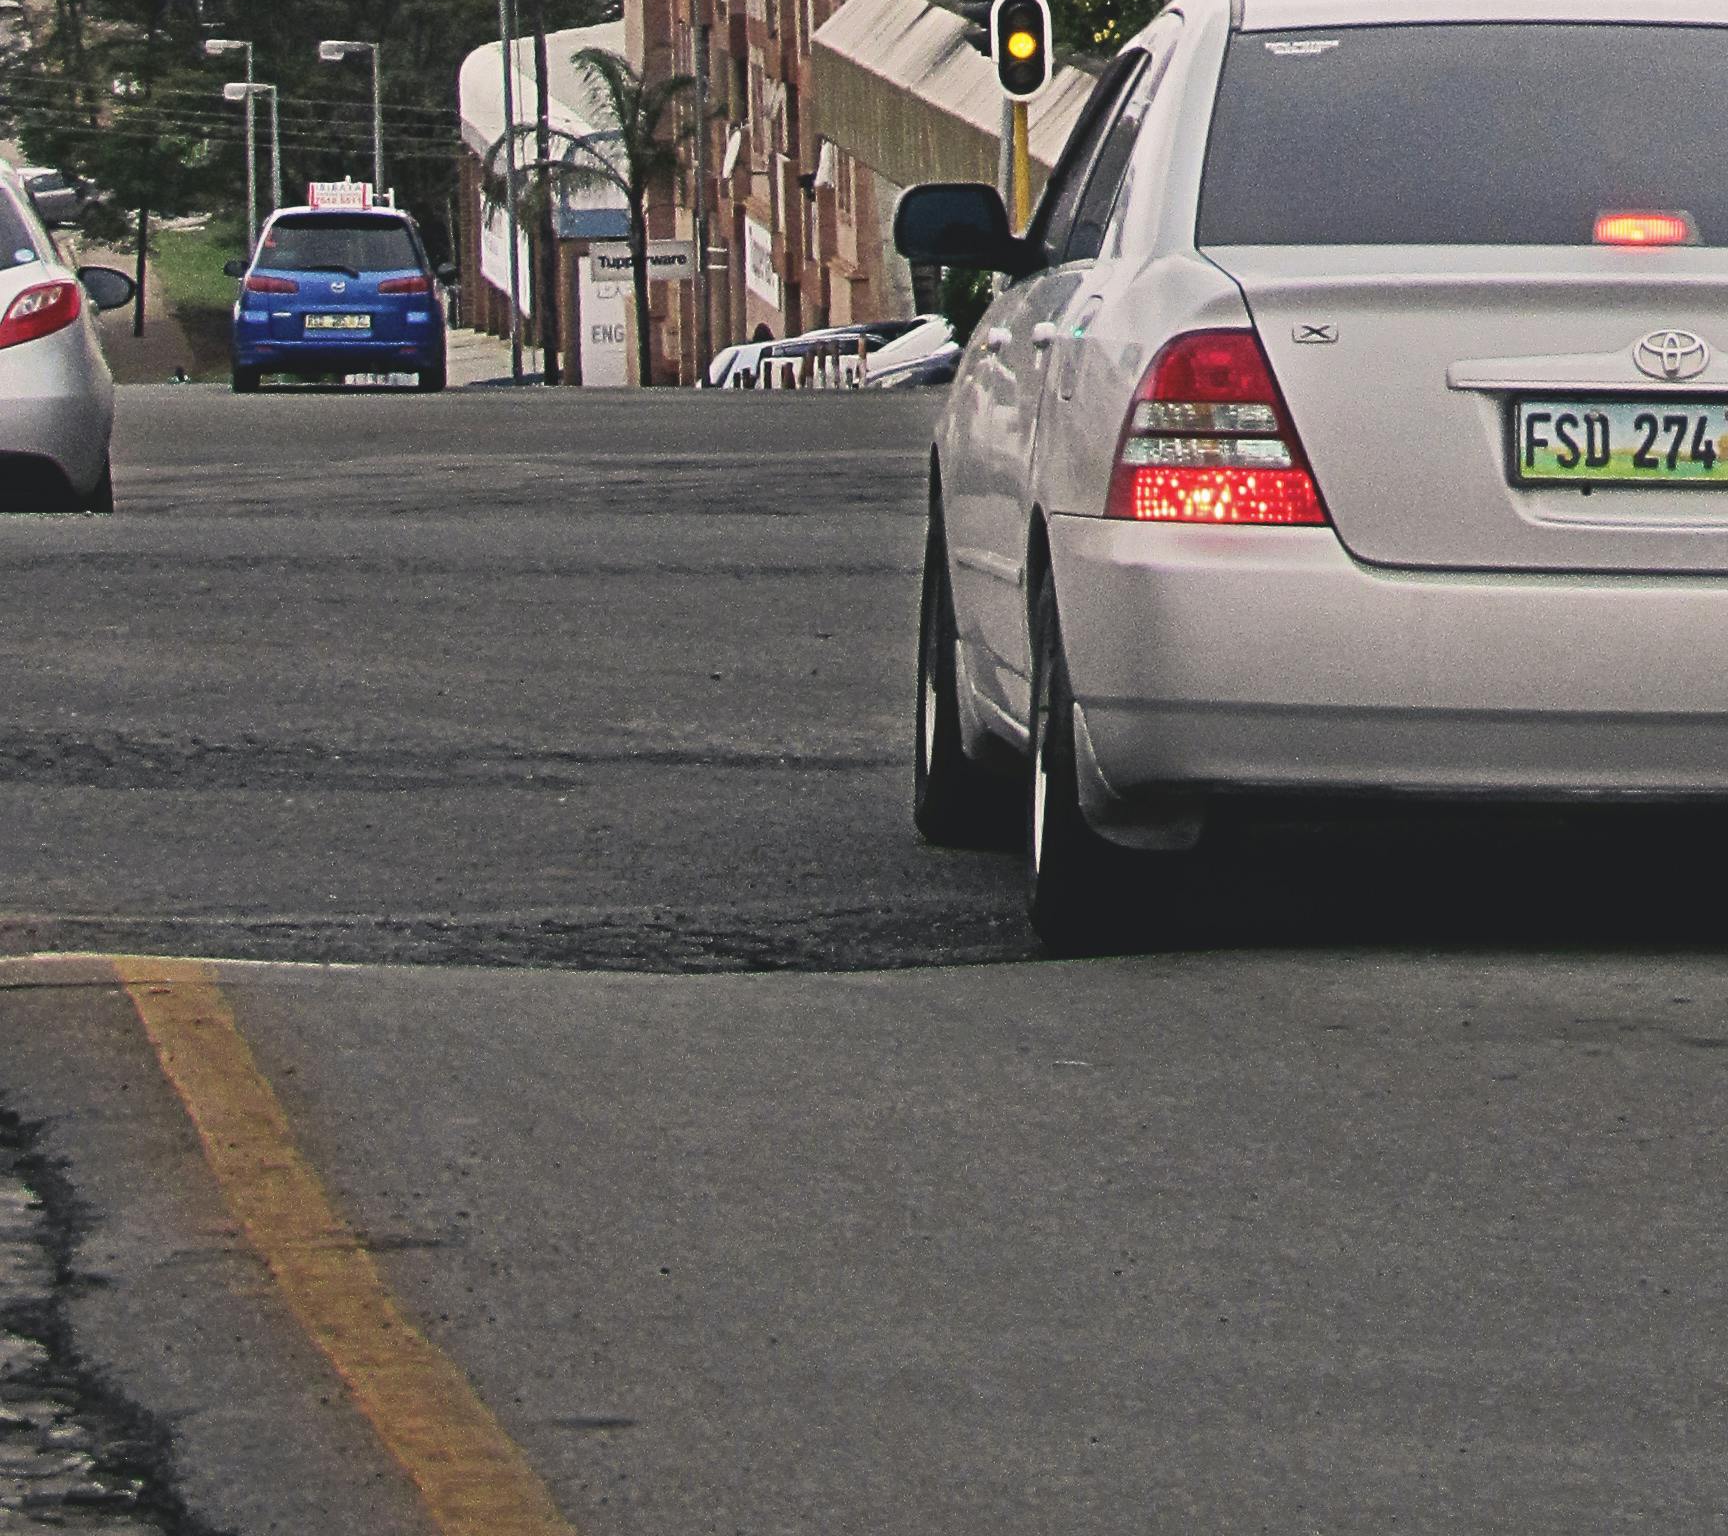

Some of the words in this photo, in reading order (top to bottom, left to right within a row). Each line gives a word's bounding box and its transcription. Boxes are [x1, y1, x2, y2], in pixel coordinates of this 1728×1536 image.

[598, 255, 687, 269] Tupprware
[1526, 412, 1610, 468] FSD
[1633, 413, 1716, 470] 274
